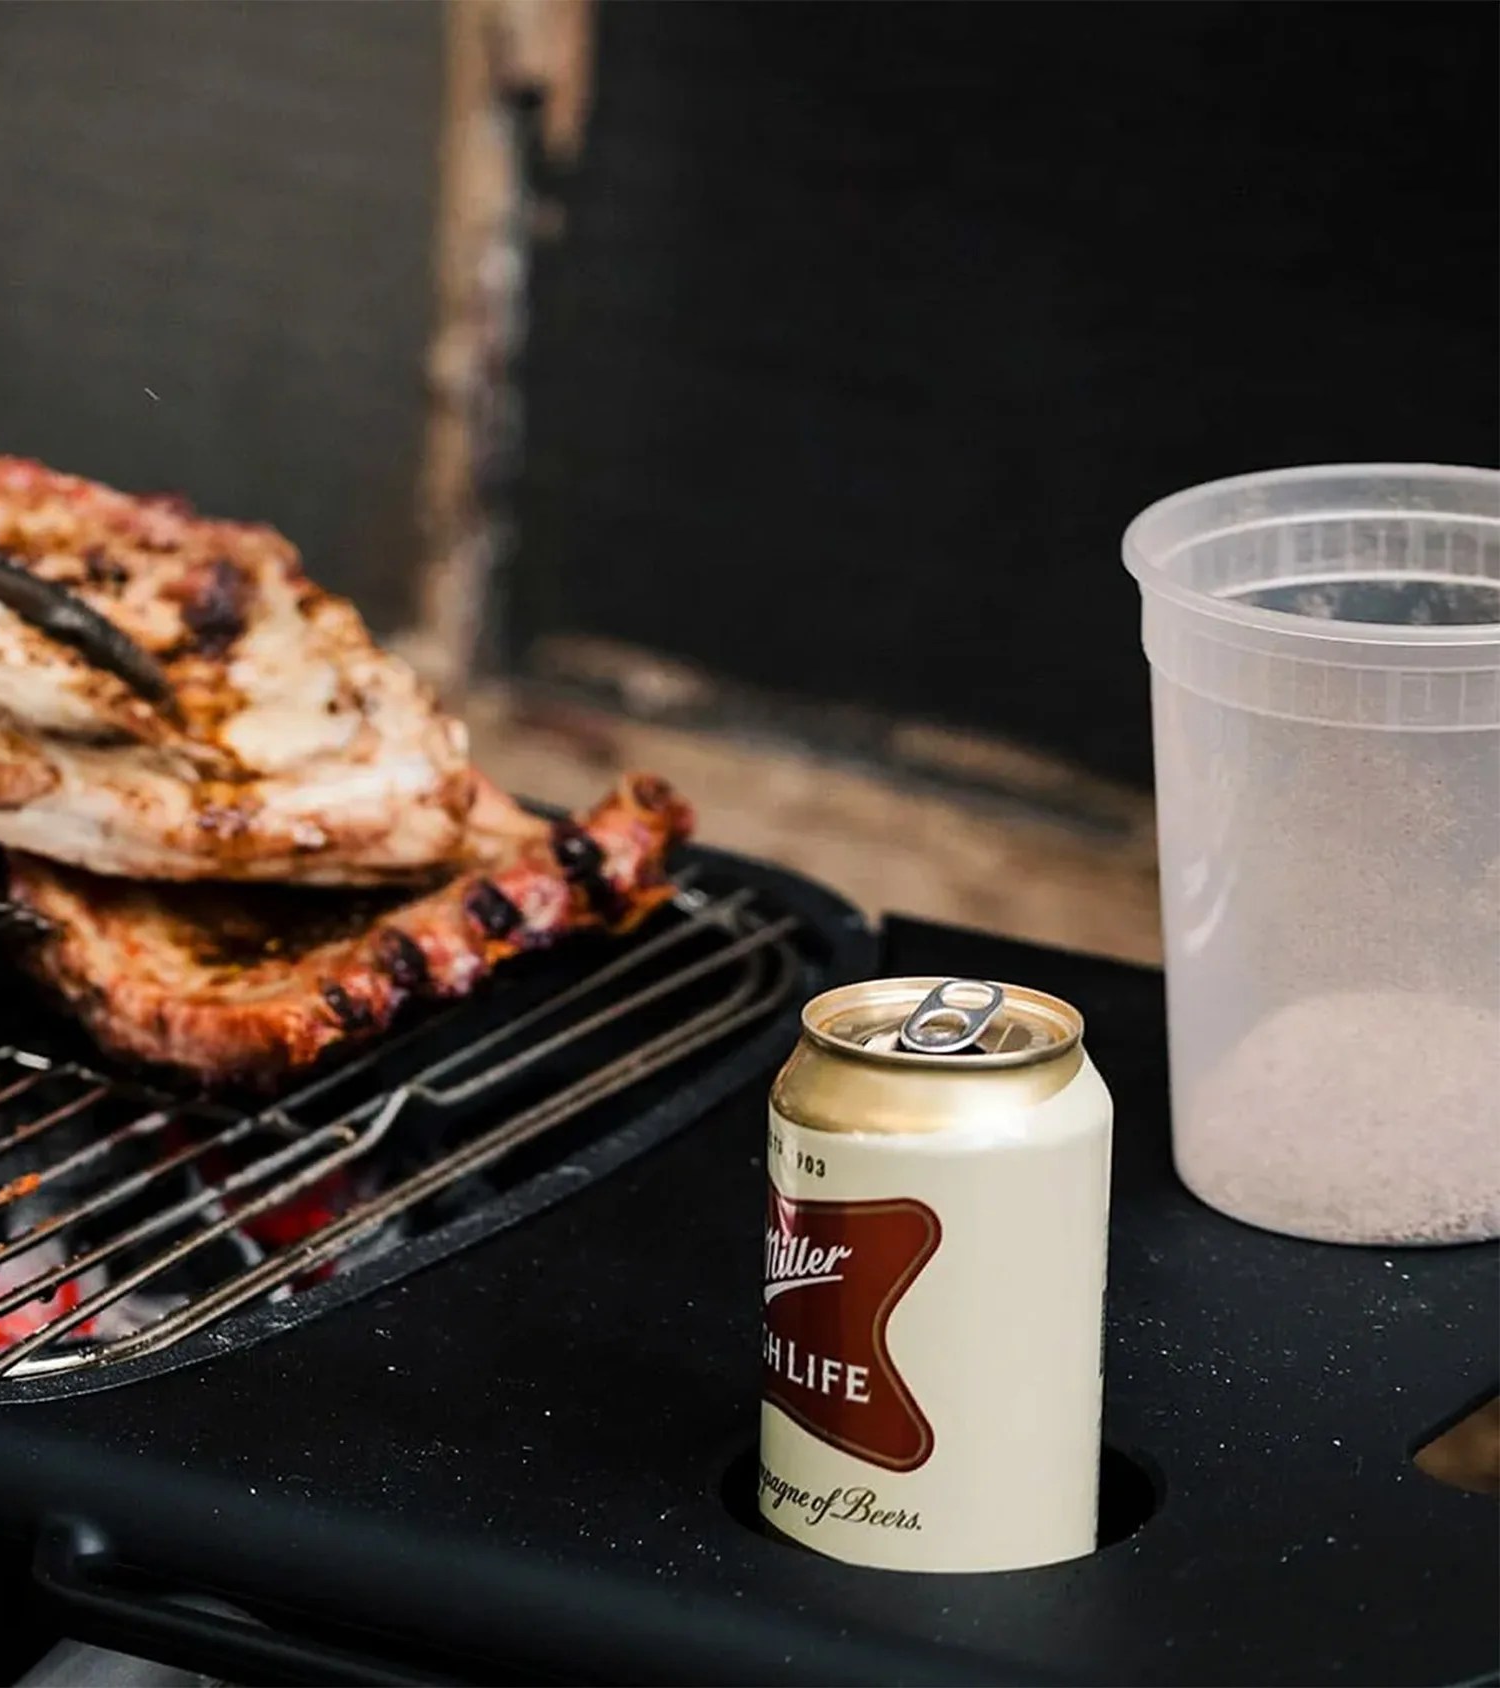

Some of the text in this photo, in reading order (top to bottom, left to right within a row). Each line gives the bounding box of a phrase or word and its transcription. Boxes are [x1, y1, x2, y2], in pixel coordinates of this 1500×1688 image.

[787, 1340, 871, 1403] LIFE
[760, 1467, 922, 1531] pagne of Beers.
